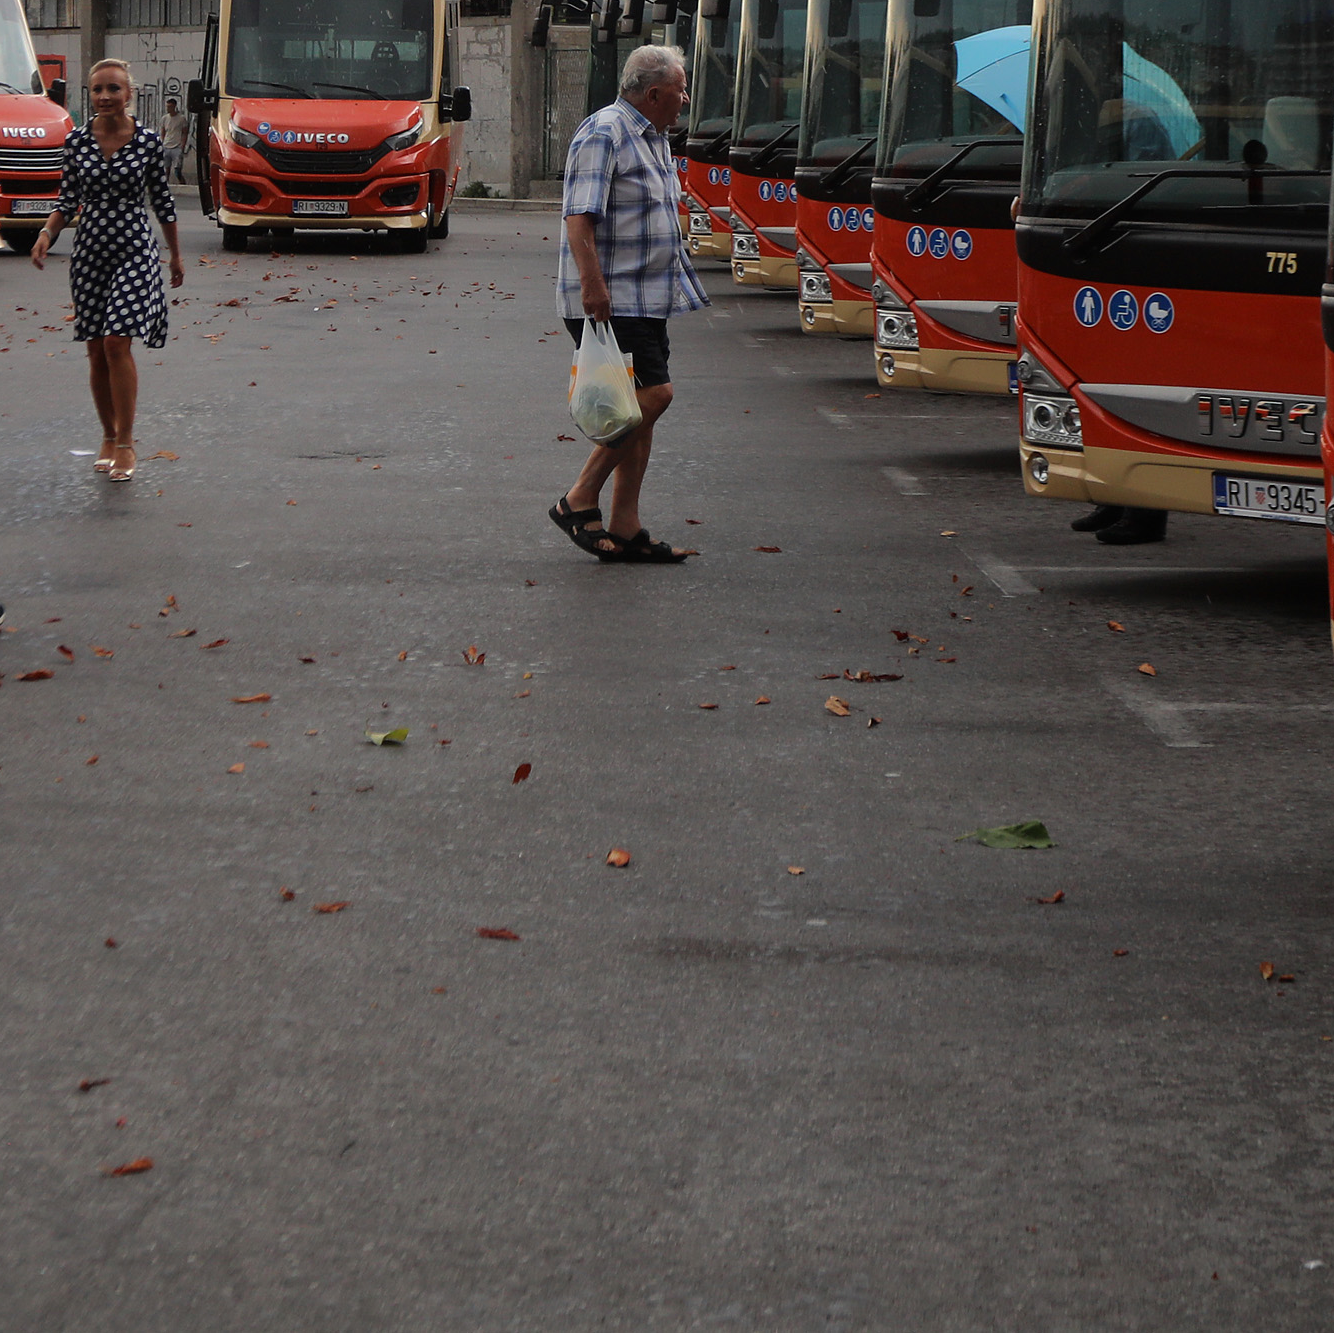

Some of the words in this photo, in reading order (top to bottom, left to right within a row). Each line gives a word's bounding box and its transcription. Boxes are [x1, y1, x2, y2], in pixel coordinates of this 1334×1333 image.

[2, 127, 46, 138] IVECO
[296, 133, 349, 144] IVECO
[299, 202, 308, 210] RI
[314, 202, 345, 212] 9329-N
[1266, 251, 1298, 274] 775
[1198, 396, 1316, 445] IVEC
[1228, 480, 1250, 508] RI
[1267, 484, 1325, 514] 9345-
